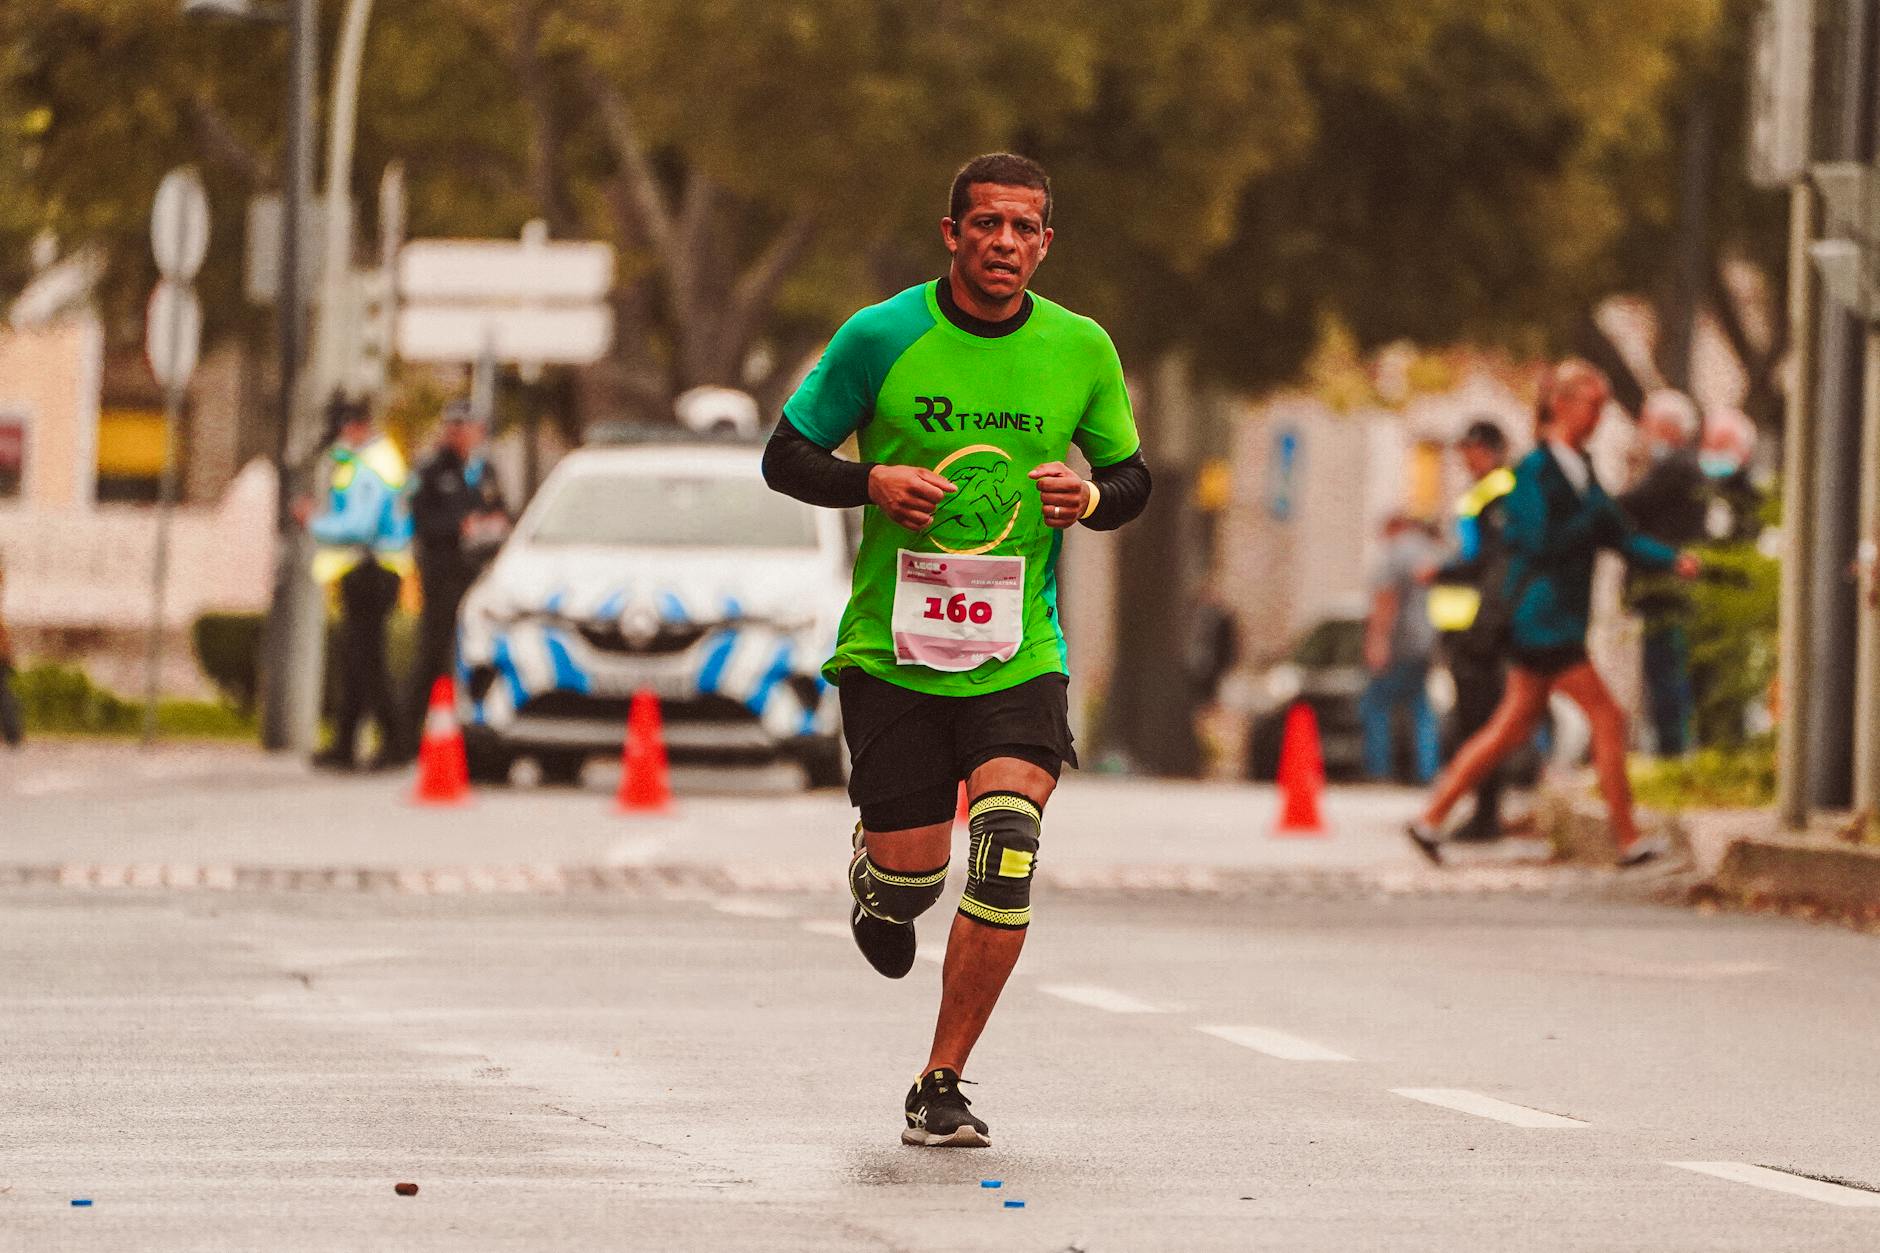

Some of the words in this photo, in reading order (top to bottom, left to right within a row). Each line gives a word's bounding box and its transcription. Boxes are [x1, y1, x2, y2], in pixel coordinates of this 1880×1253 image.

[914, 396, 954, 432] RR
[956, 411, 1043, 433] TRAINER
[923, 593, 992, 624] 160
